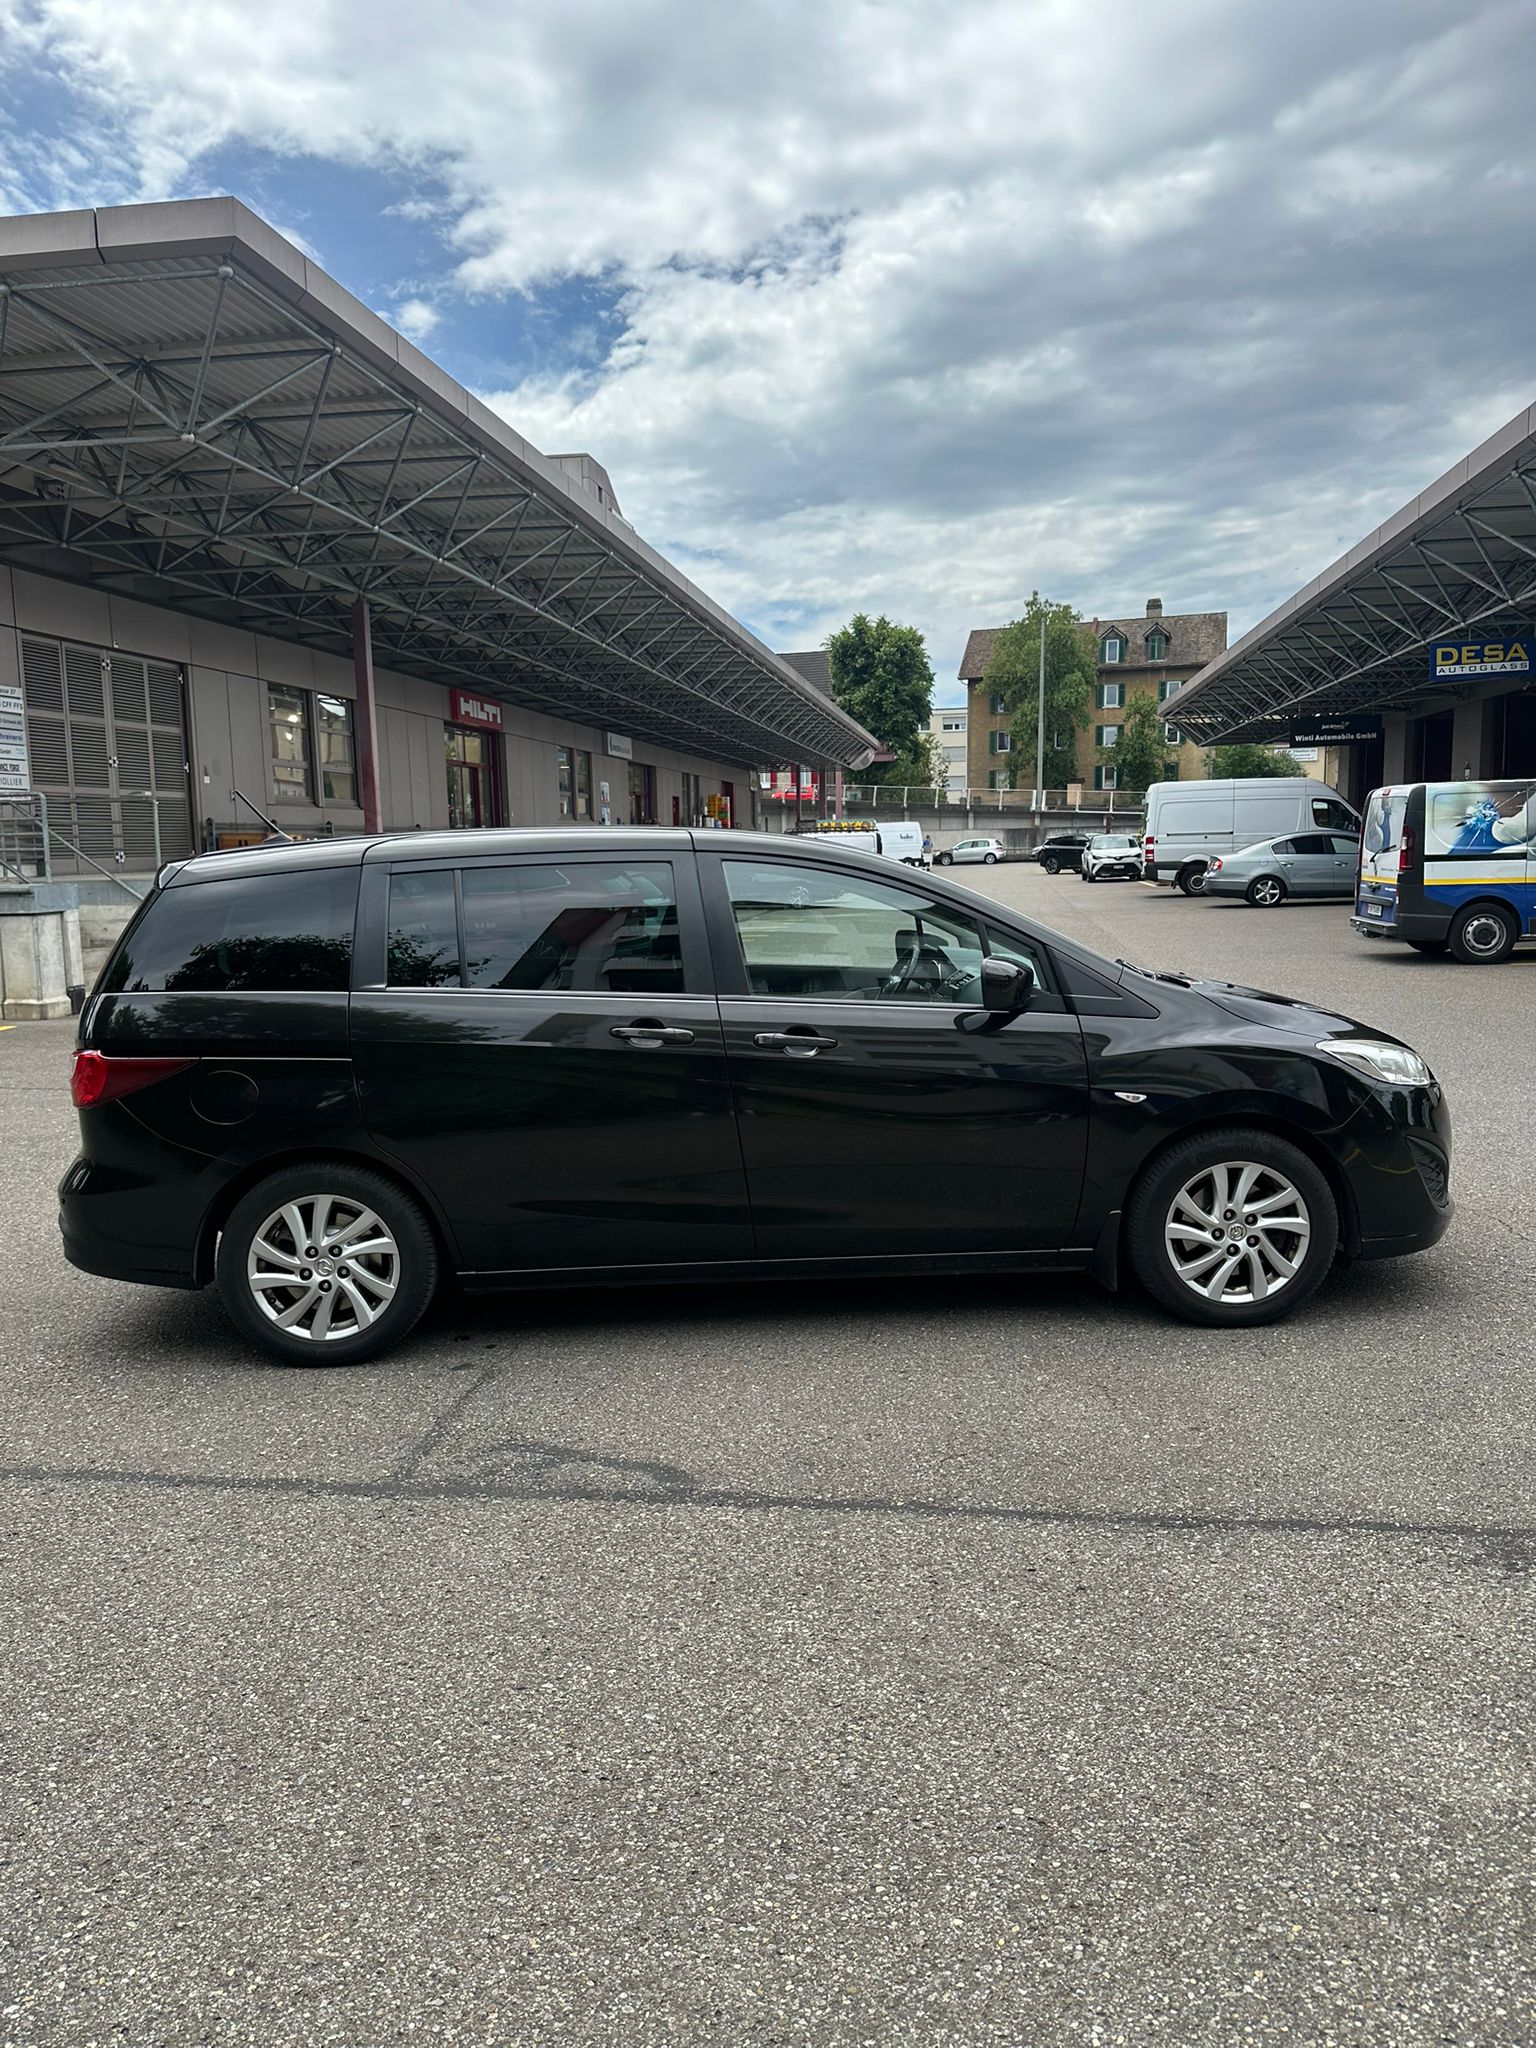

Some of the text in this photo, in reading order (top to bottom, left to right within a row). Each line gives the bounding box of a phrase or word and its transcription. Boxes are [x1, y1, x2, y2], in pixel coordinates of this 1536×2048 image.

[1436, 642, 1528, 666] DESA
[1438, 662, 1528, 674] AUTOGLASS
[460, 697, 501, 724] HILTI
[1315, 733, 1354, 741] Automobile
